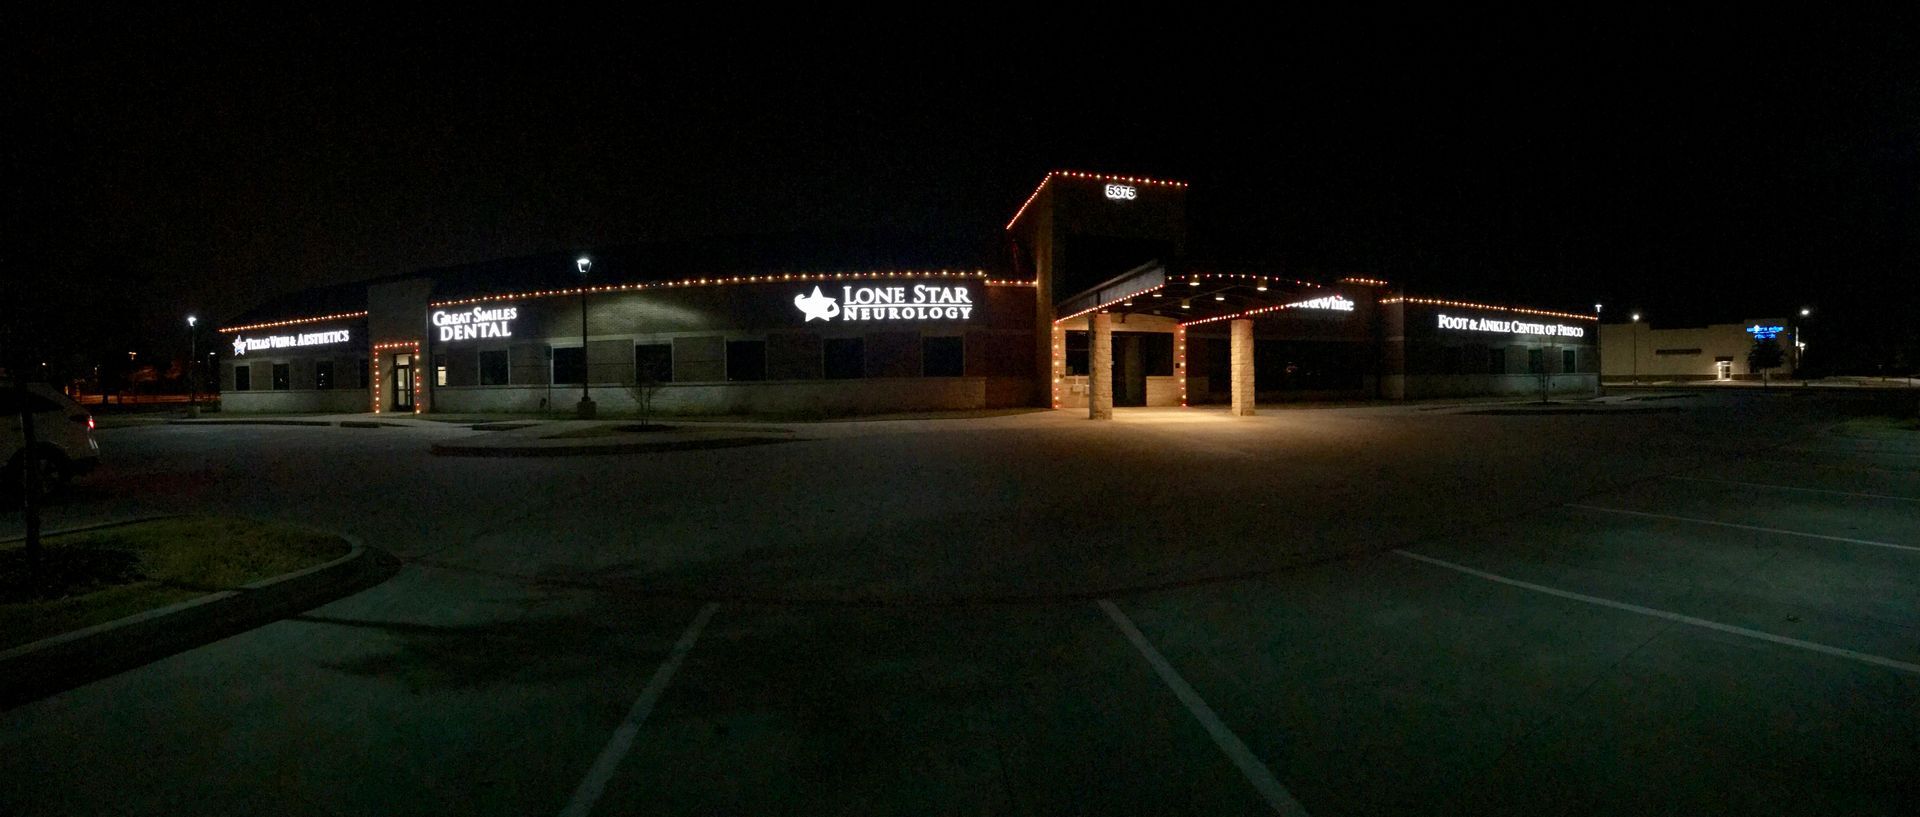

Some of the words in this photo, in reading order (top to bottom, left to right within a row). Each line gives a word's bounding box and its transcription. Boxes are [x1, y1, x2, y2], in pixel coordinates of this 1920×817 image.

[1106, 184, 1136, 199] 5375
[843, 286, 905, 304] LONE
[914, 284, 973, 304] STAR
[432, 311, 473, 326] GREAT
[473, 306, 517, 322] SMILES
[843, 307, 972, 321] NEUROLOGY
[440, 321, 512, 341] DENTAL
[1438, 314, 1468, 330] FOOT
[1469, 319, 1478, 330] &
[1479, 318, 1510, 332] ANKLE
[1511, 320, 1544, 335] CENTER
[1545, 324, 1556, 336] OF
[1557, 324, 1584, 337] FRISCO
[246, 338, 270, 350] TEXAS
[269, 335, 290, 348] VEIN
[289, 335, 297, 346] &
[297, 330, 349, 346] AESTHETICS
